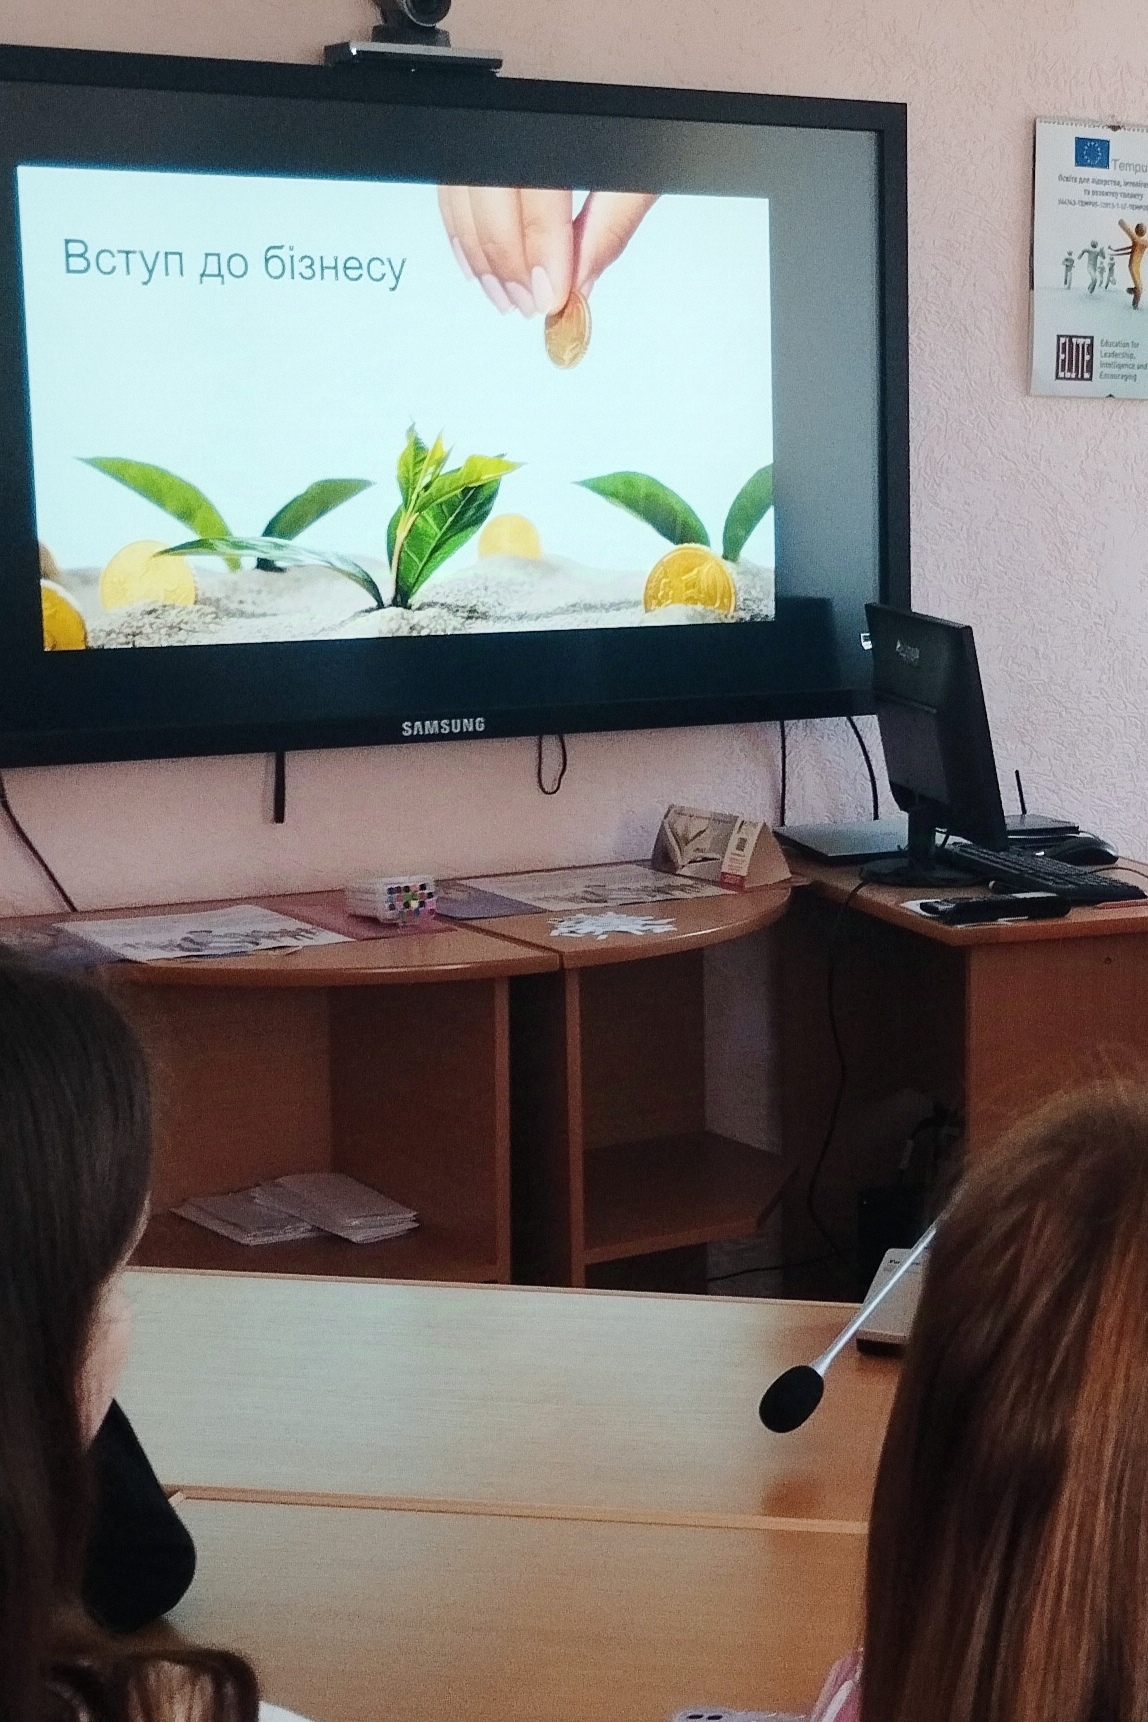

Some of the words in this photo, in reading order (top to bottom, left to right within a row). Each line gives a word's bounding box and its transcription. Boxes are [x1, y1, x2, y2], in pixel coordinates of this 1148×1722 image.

[64, 238, 184, 286] Вступ
[200, 252, 249, 285] до
[264, 244, 407, 292] бізнесу
[1100, 339, 1130, 348] Education
[1130, 340, 1140, 349] for
[1058, 337, 1091, 378] ELITE
[1099, 360, 1136, 371] Intelligence
[1136, 362, 1148, 371] and
[1099, 371, 1137, 382] Encouraging
[401, 717, 486, 737] SAMSUNG
